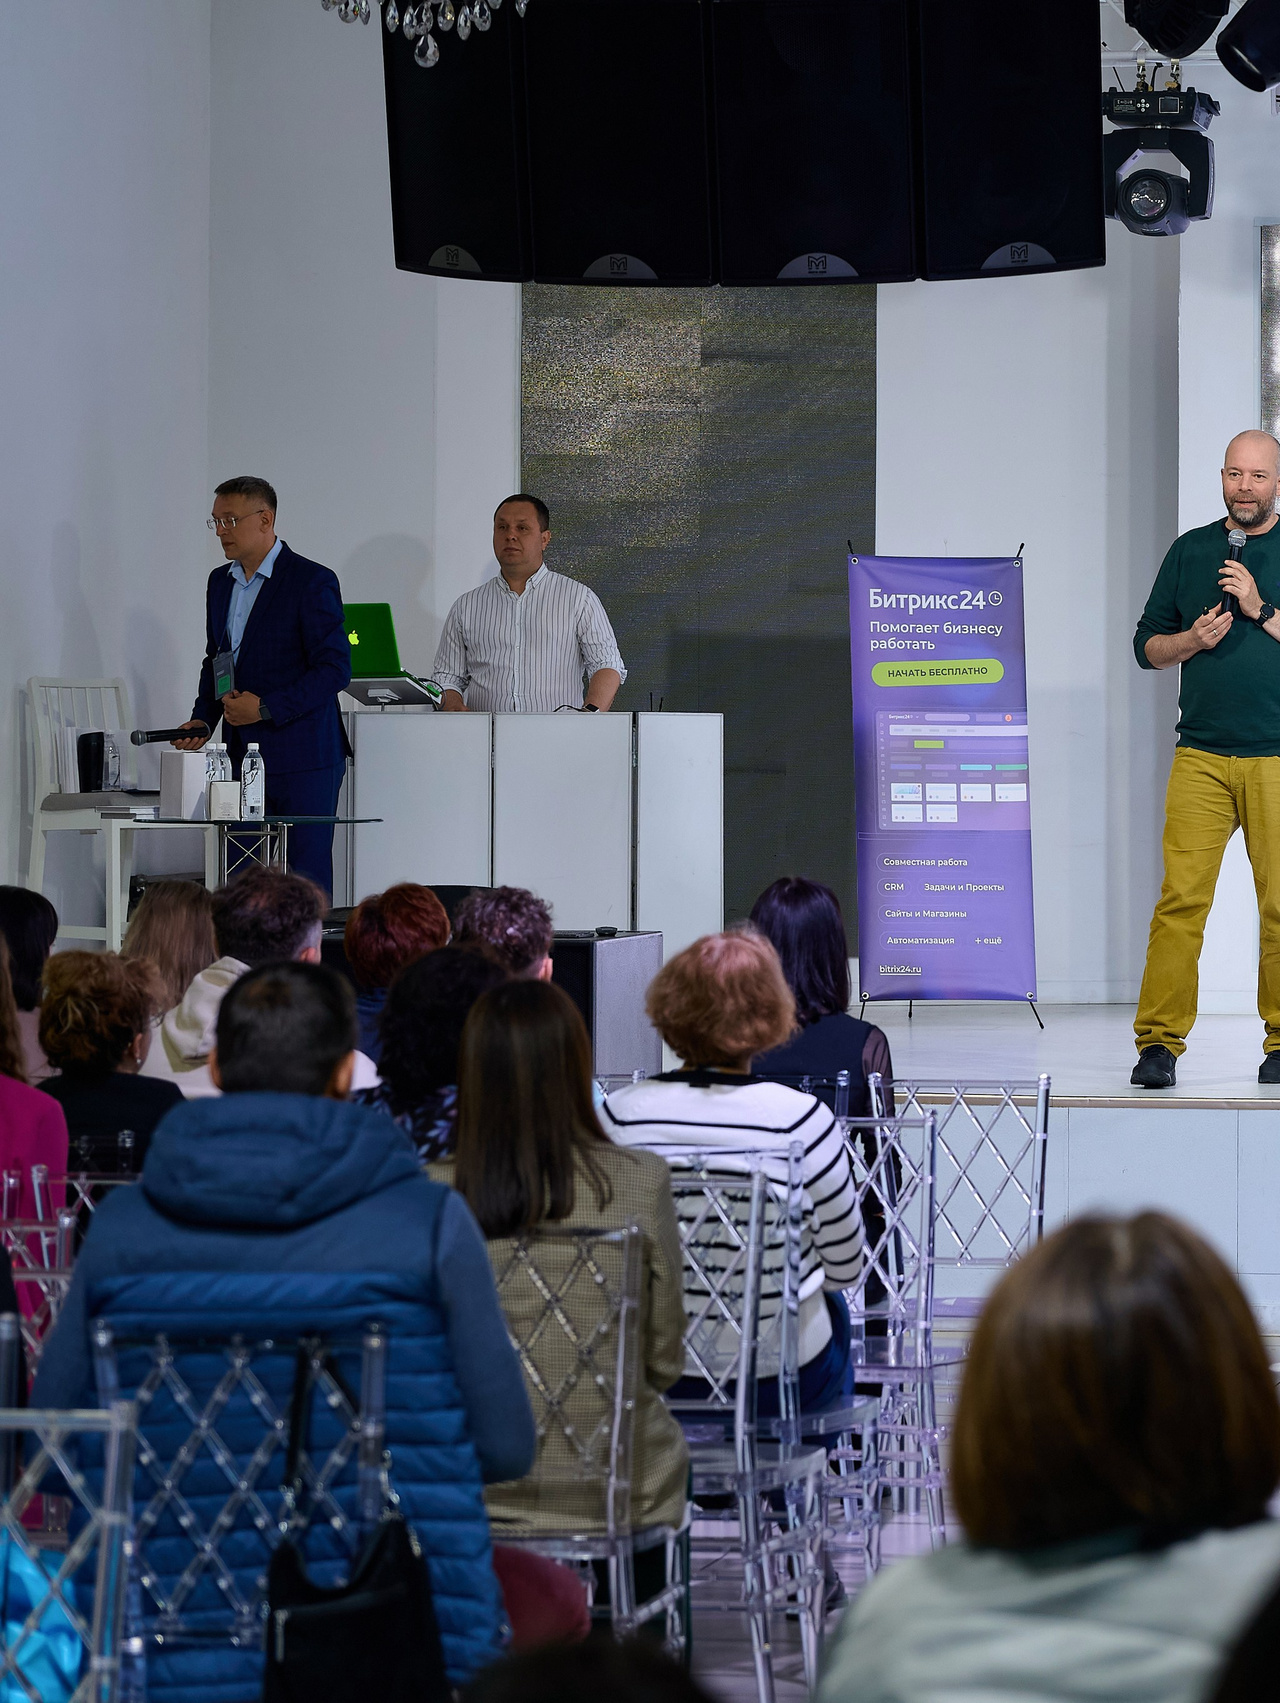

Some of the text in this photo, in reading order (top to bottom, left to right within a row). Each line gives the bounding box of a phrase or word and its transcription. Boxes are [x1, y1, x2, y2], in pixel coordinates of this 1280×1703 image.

[869, 588, 987, 615] Битрикс24
[870, 621, 1003, 637] Помогает бизнесу
[870, 638, 936, 651] работать
[887, 667, 988, 678] НАЧАТЬ БЕСПЛАТНО
[883, 858, 968, 868] Совместная работа
[884, 883, 905, 891] CRM
[924, 883, 956, 892] Задачи
[966, 883, 1005, 893] Проекты
[885, 909, 913, 918] Сайты
[922, 910, 967, 918] Магазины
[887, 937, 955, 945] Автоматизация
[983, 936, 1002, 945] ещё
[879, 965, 922, 975] bitrix24.ru
